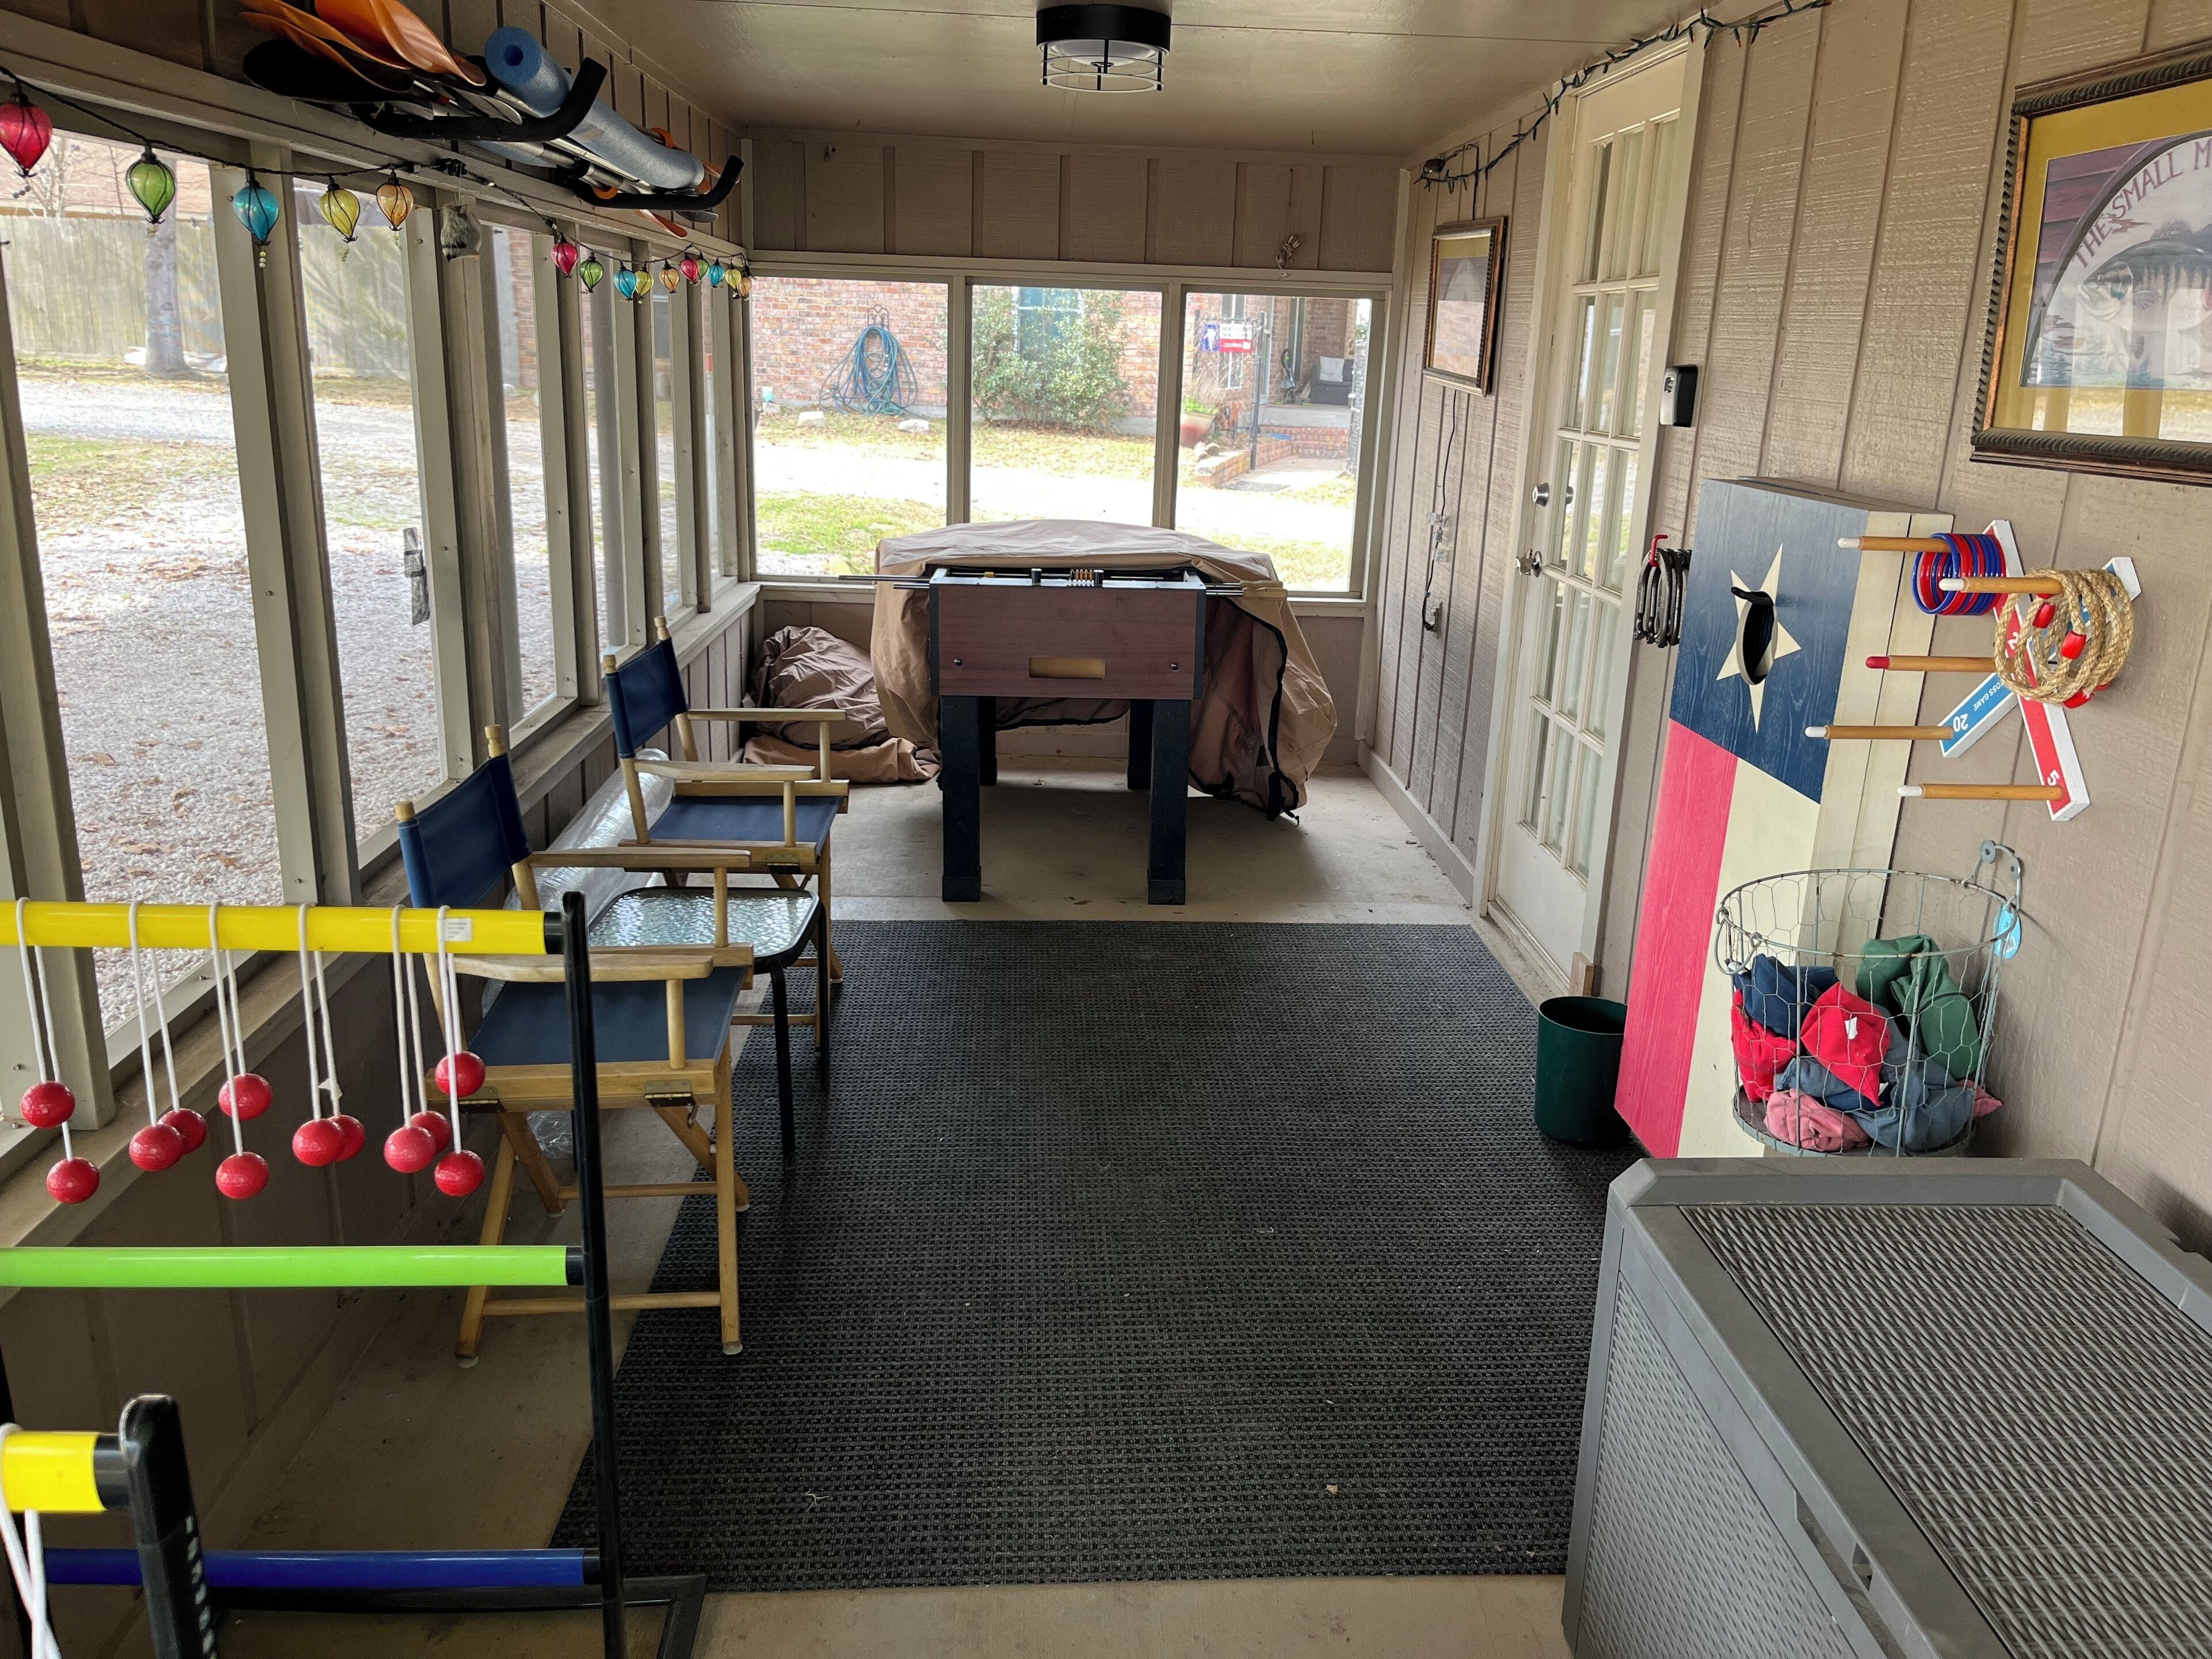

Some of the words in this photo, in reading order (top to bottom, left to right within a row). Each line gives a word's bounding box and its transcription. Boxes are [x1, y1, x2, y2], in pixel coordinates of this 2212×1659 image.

[2073, 221, 2113, 268] THE
[2112, 151, 2184, 218] SMALL
[1972, 694, 1989, 712] GAME
[1953, 713, 1968, 732] 20
[2047, 769, 2060, 786] 5
